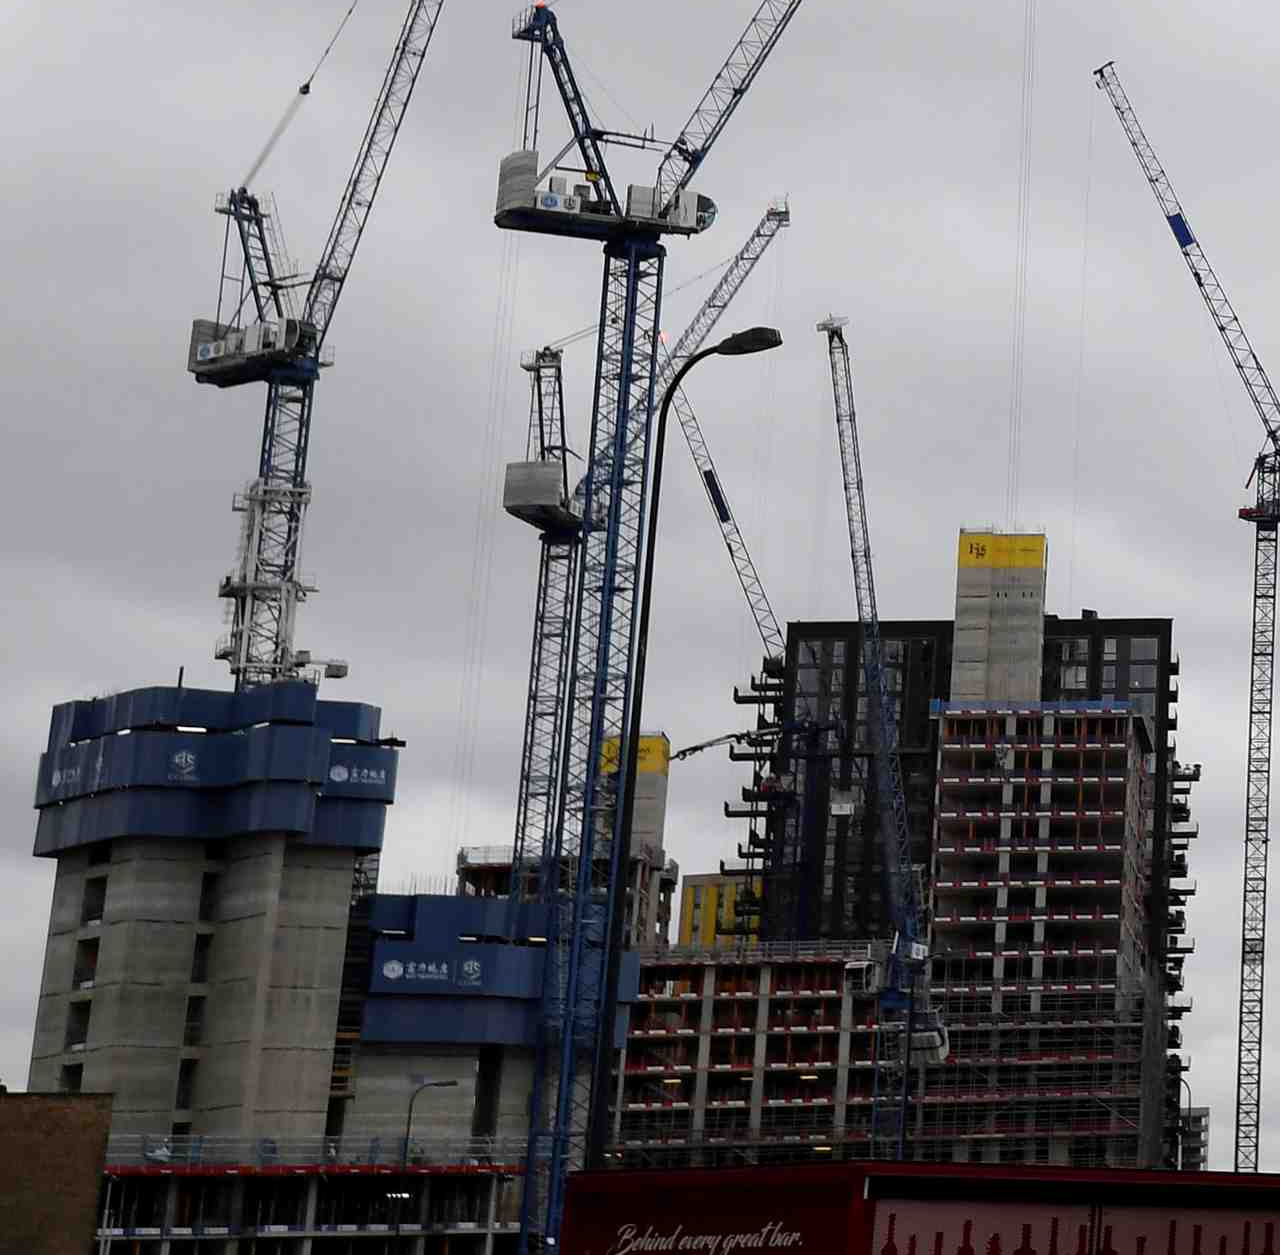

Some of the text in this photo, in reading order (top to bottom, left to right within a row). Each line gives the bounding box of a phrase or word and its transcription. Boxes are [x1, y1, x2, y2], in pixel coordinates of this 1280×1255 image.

[606, 1221, 803, 1255] Behind every great bar.
